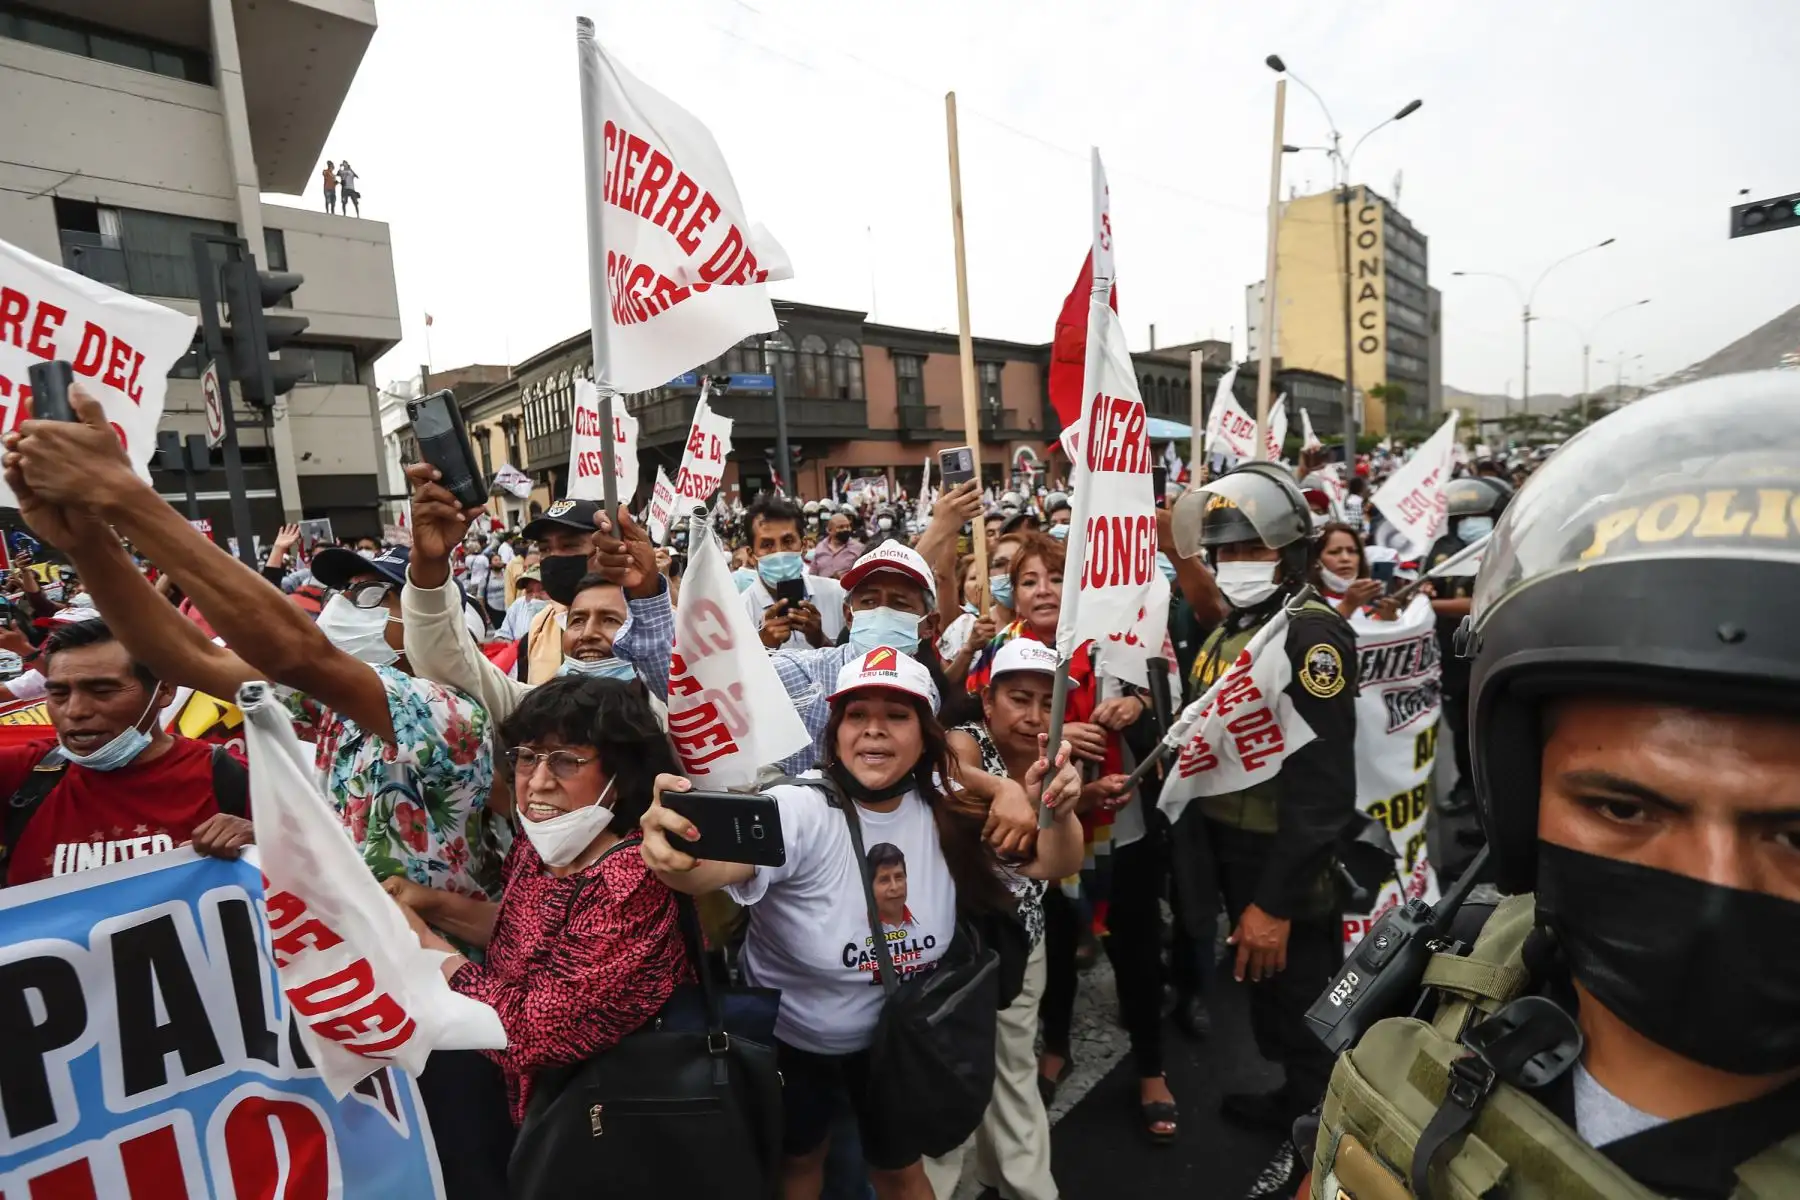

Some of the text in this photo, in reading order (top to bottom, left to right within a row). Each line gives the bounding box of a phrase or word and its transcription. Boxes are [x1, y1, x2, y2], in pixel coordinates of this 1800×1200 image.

[603, 119, 721, 257] CIERRE
[607, 250, 712, 326] CONGR
[1357, 205, 1379, 354] CONACO
[0, 286, 146, 408] RE DEL
[1231, 416, 1255, 440] DEL
[878, 670, 899, 678] LIBRE
[668, 701, 740, 775] DEL
[1226, 707, 1285, 772] DEL
[53, 833, 173, 878] UNITED
[859, 951, 922, 972] PREENTE
[865, 929, 908, 947] PRO
[0, 898, 400, 1139] PAL
[285, 957, 417, 1060] DEL
[1329, 970, 1359, 1006] 0530
